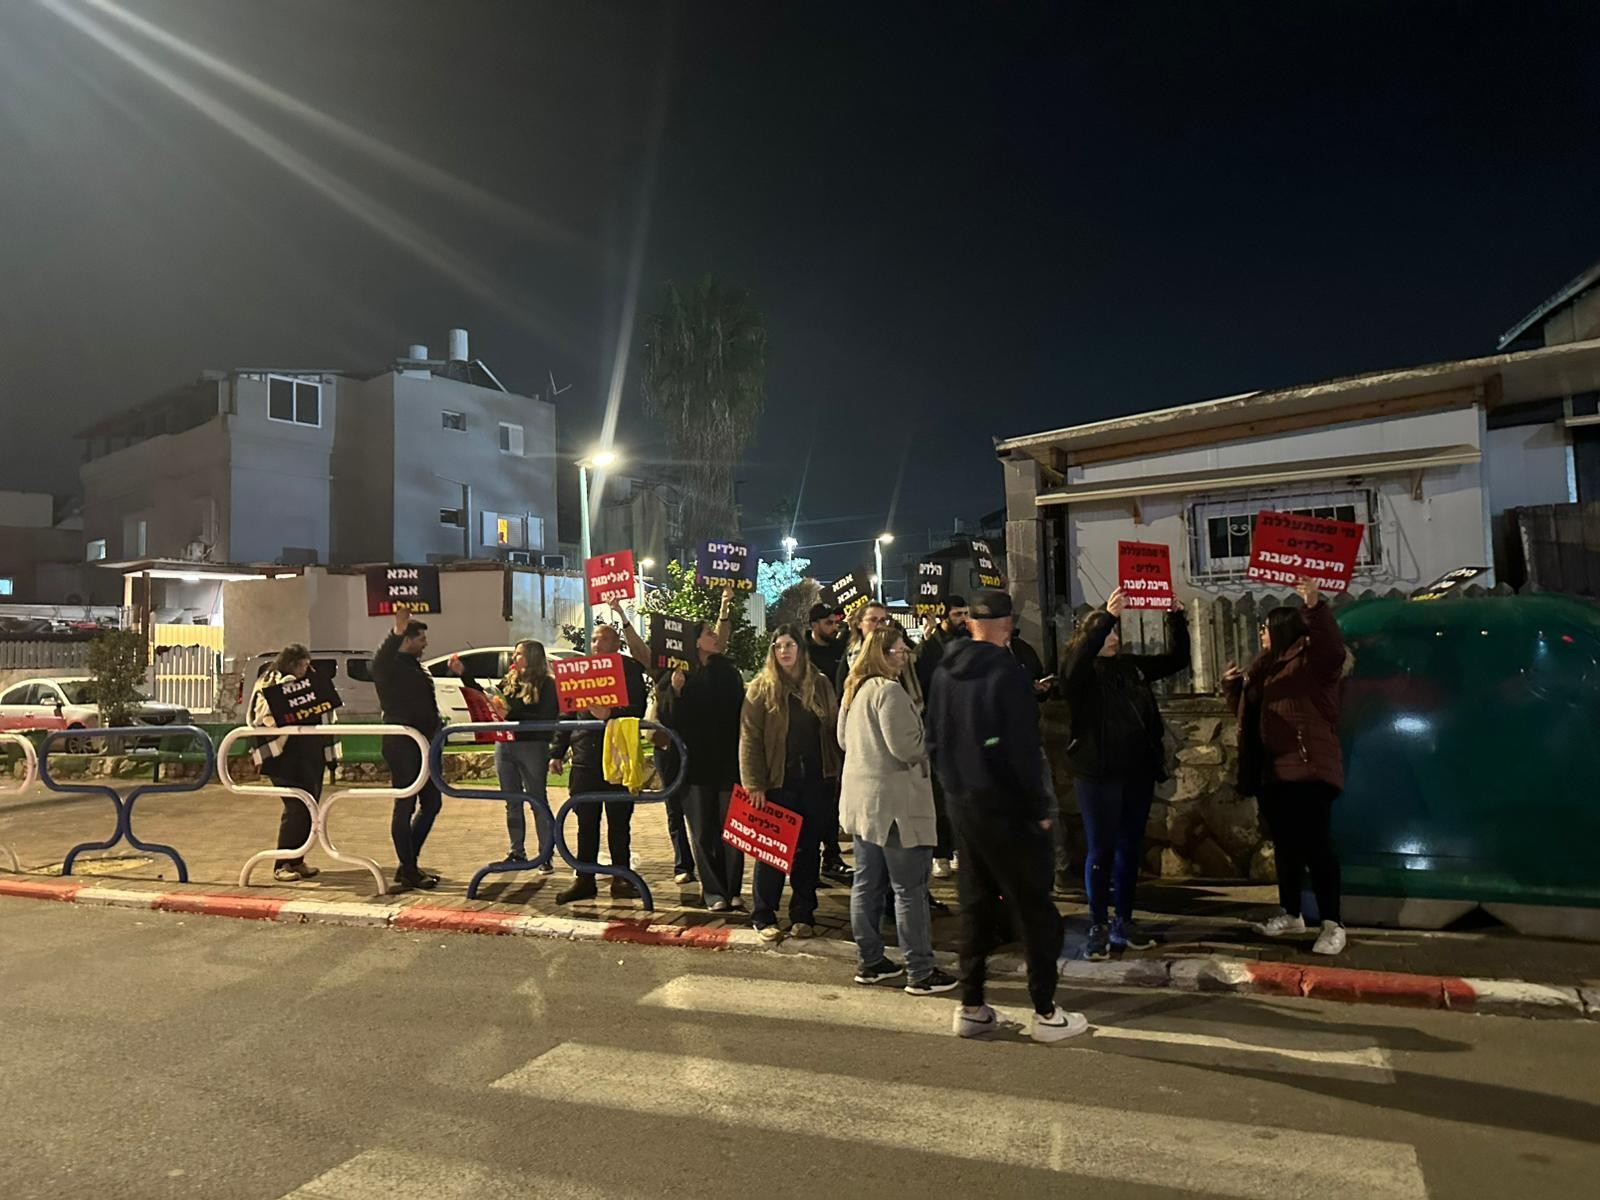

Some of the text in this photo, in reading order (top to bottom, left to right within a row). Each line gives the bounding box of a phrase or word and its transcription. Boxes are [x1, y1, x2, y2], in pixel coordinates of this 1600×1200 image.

[708, 542, 747, 557] הילדים
[712, 559, 740, 572] שלנו
[1258, 550, 1345, 572] חייבת לשבת
[387, 568, 418, 579] אמא
[590, 569, 630, 588] לאלימות
[1248, 567, 1296, 583] סורגים
[388, 585, 418, 596] אבא
[737, 578, 753, 590] לא
[831, 573, 854, 592] אמא
[1123, 578, 1169, 590] חייבת לשבת
[837, 586, 858, 604] אבא
[664, 619, 682, 632] אמא
[665, 638, 683, 651] אבא
[557, 658, 613, 674] מה קורה
[282, 678, 311, 695] אמא
[560, 676, 616, 692] כשהדלת
[288, 691, 317, 708] אבא
[576, 694, 618, 708] נסגרת
[747, 813, 780, 834] בילדים
[785, 814, 797, 826] מי
[730, 818, 788, 853] חייבת לשבת
[723, 829, 789, 870] מאחורי סורגים
